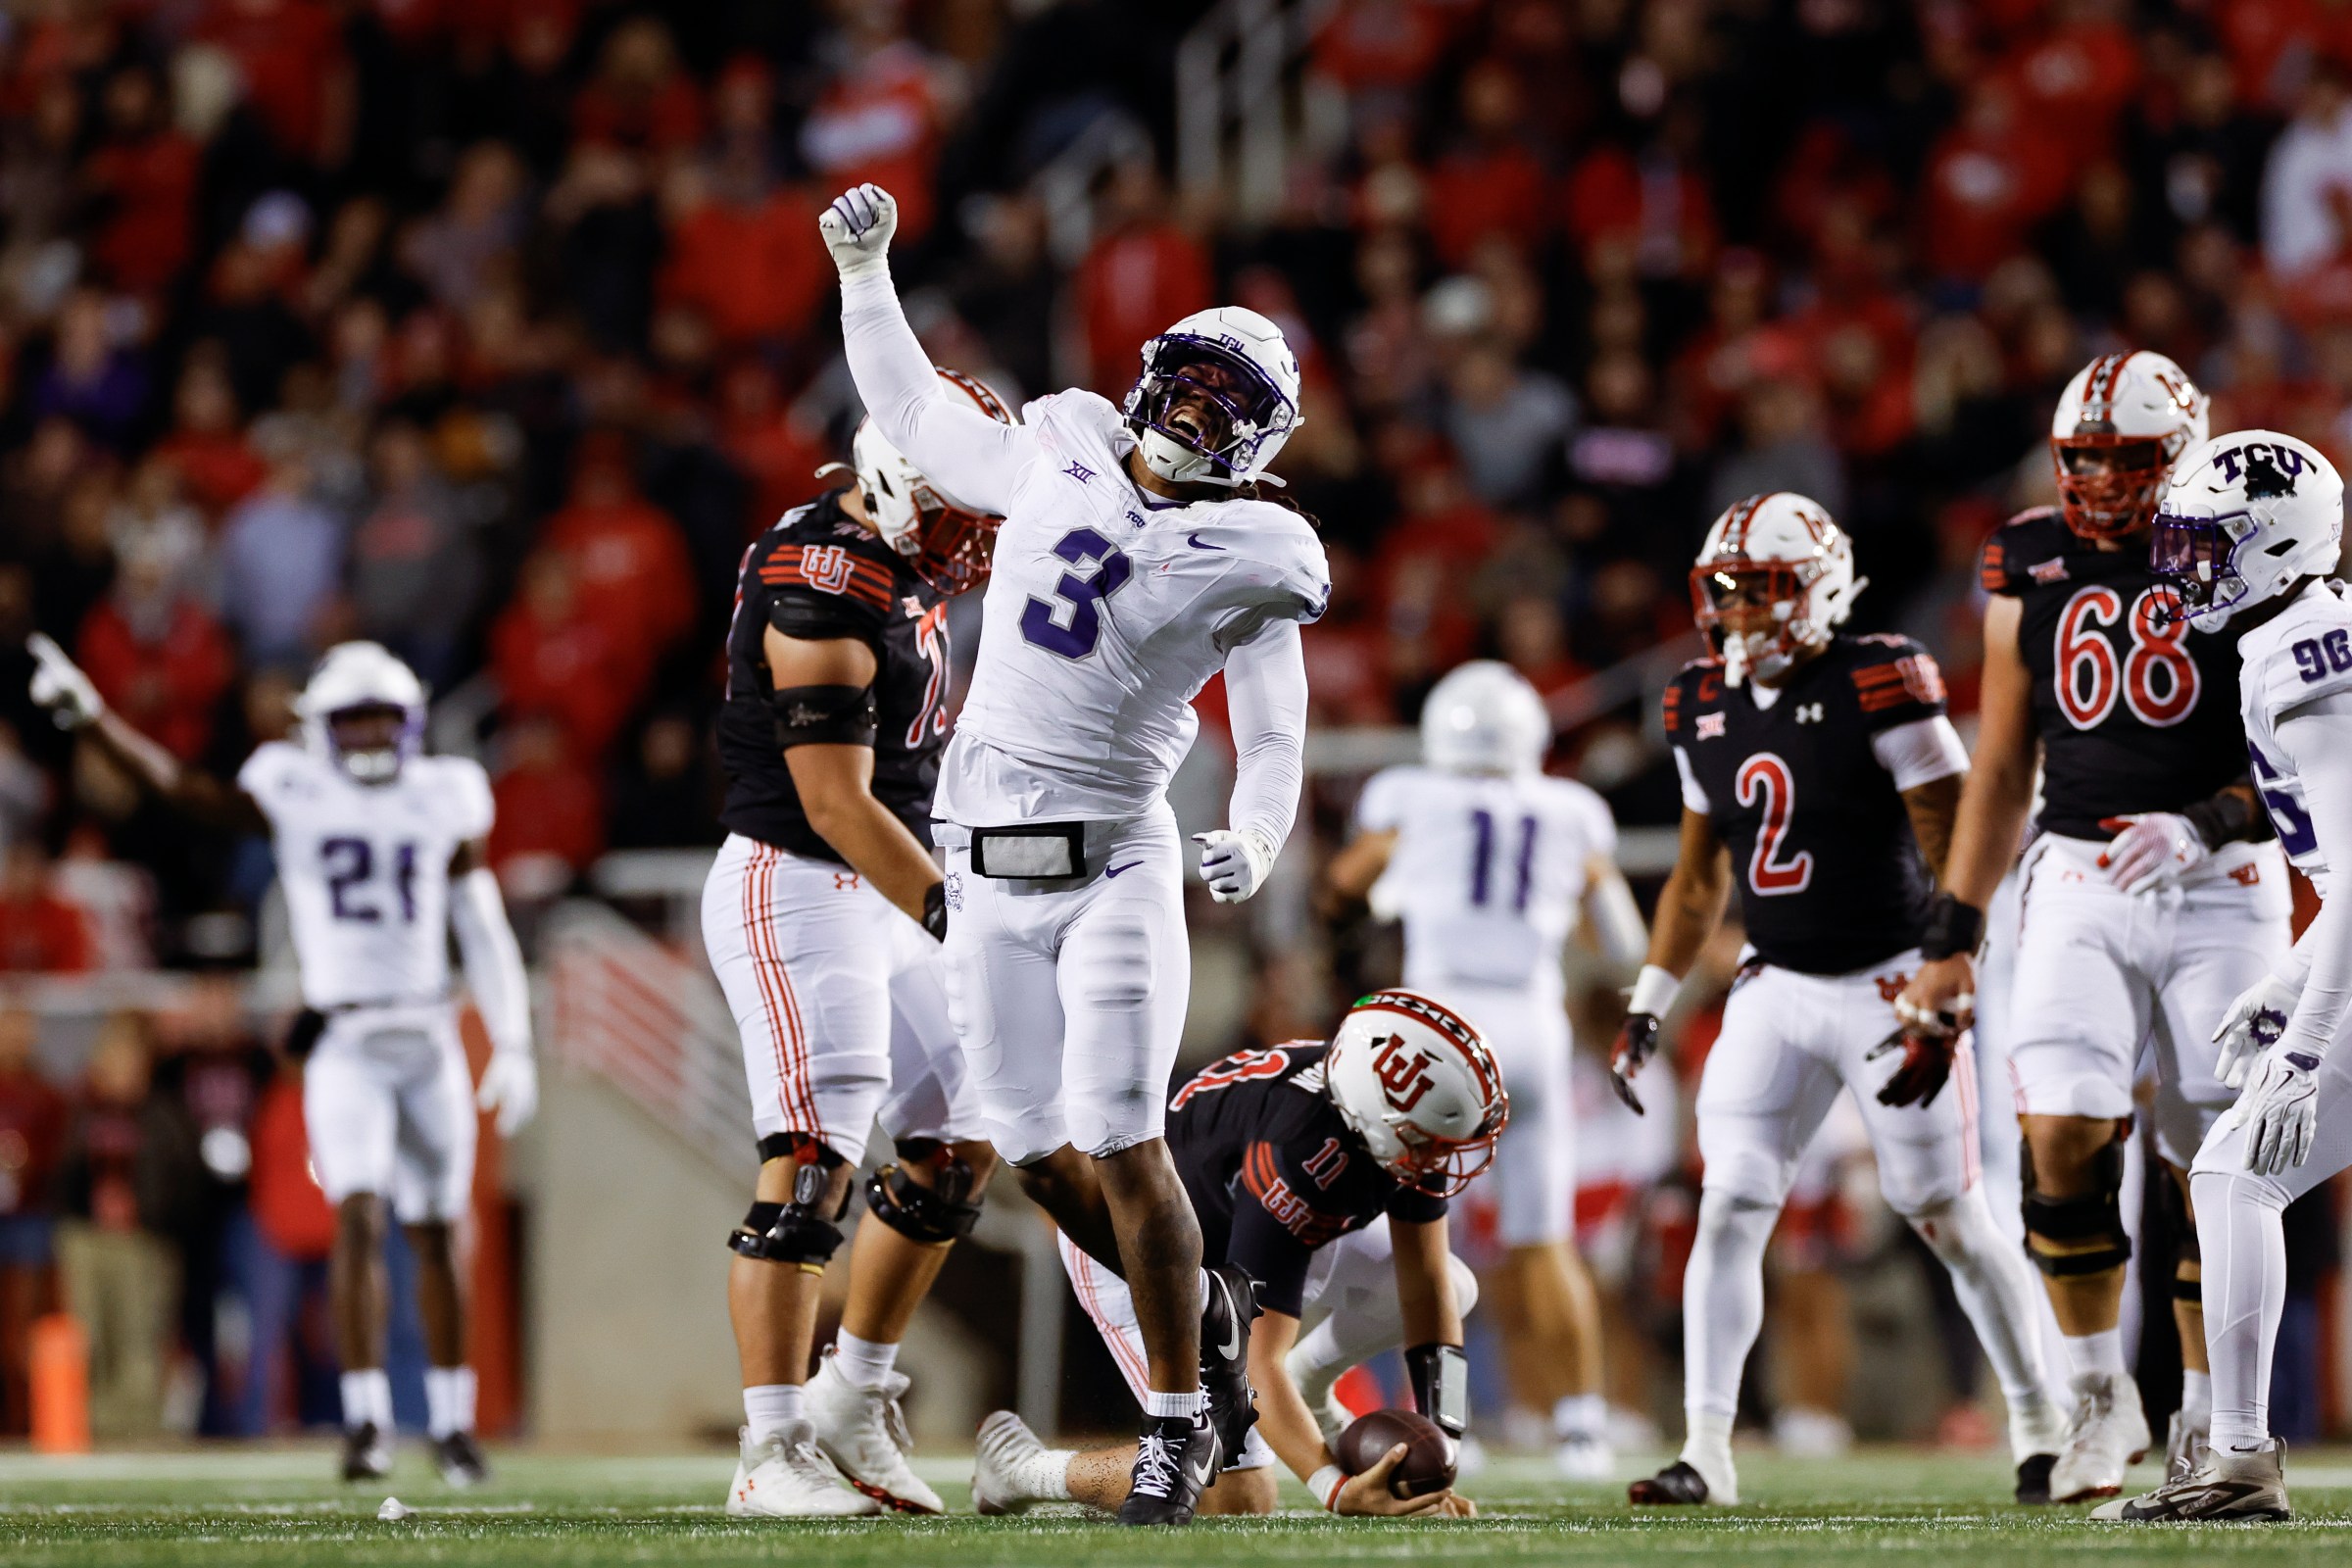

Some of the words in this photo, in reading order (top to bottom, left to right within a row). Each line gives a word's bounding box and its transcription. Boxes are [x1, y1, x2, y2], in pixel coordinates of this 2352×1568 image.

[1219, 332, 1245, 352] TCU
[1062, 460, 1099, 485] XII
[2212, 443, 2303, 485] TCU
[1125, 510, 1146, 529] TCU
[1017, 525, 1134, 663] 3
[2054, 585, 2202, 730] 68
[2291, 628, 2352, 684] 96
[1735, 752, 1814, 897] 2
[319, 836, 416, 923] 21
[1468, 808, 1538, 915] 11
[1301, 1137, 1349, 1191] 11
[2183, 1492, 2222, 1514] ALPHA
